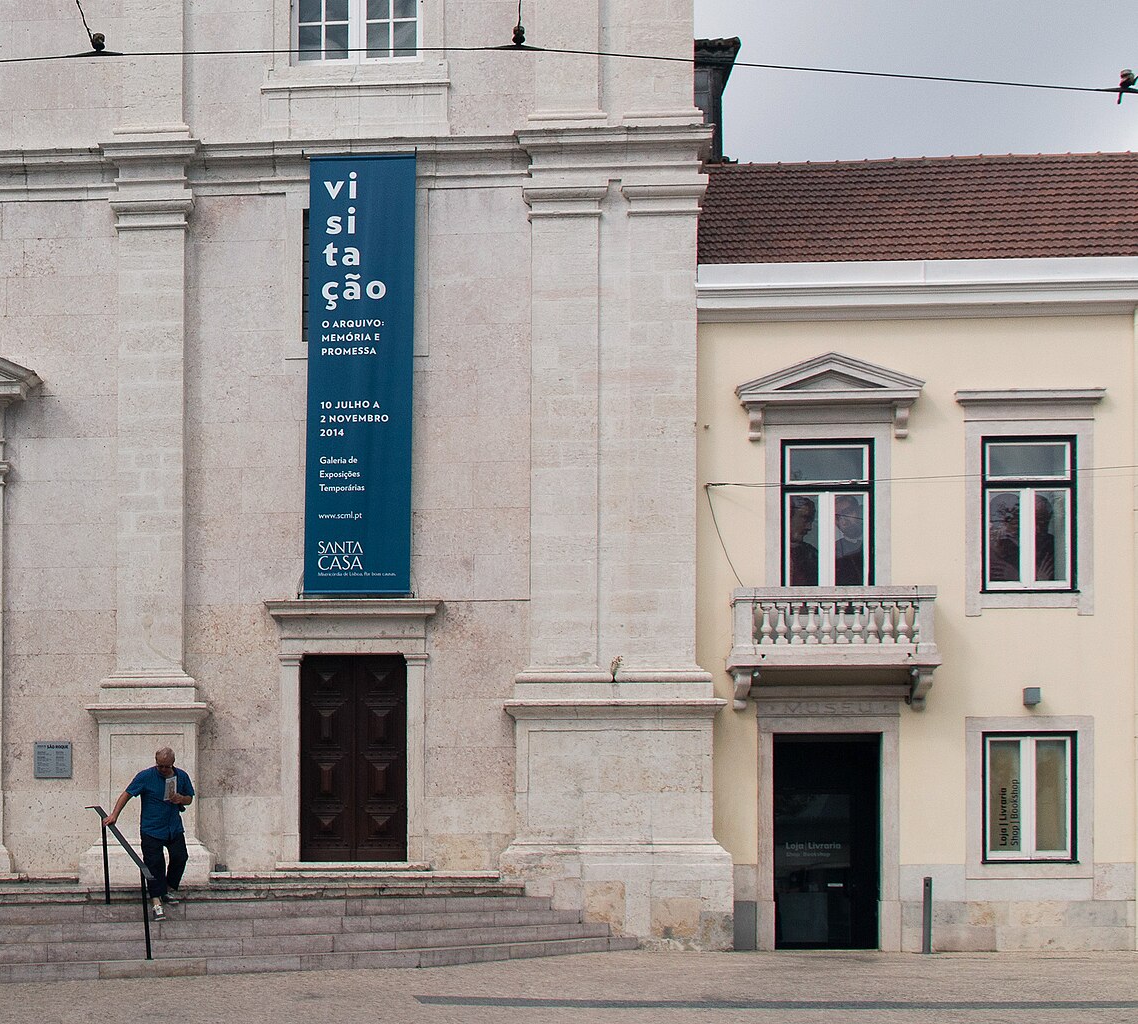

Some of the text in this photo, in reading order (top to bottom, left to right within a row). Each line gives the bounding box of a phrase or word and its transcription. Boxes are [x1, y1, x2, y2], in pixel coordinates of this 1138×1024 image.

[324, 172, 357, 199] vi
[326, 207, 355, 234] si
[323, 242, 359, 266] ta
[322, 274, 386, 310] ção
[322, 332, 371, 342] MEMÓRIA
[322, 347, 376, 355] PROMESSA
[320, 470, 360, 479] Exposições
[319, 484, 364, 493] Temporárias
[319, 511, 362, 520] www.scml.pt
[317, 541, 363, 553] SANTA
[317, 556, 363, 570] CASA
[784, 702, 872, 714] MUSEU
[999, 787, 1009, 846] Loja Livraria
[1010, 779, 1020, 846] Shop Bookshop
[786, 842, 842, 851] Loja Livraria
